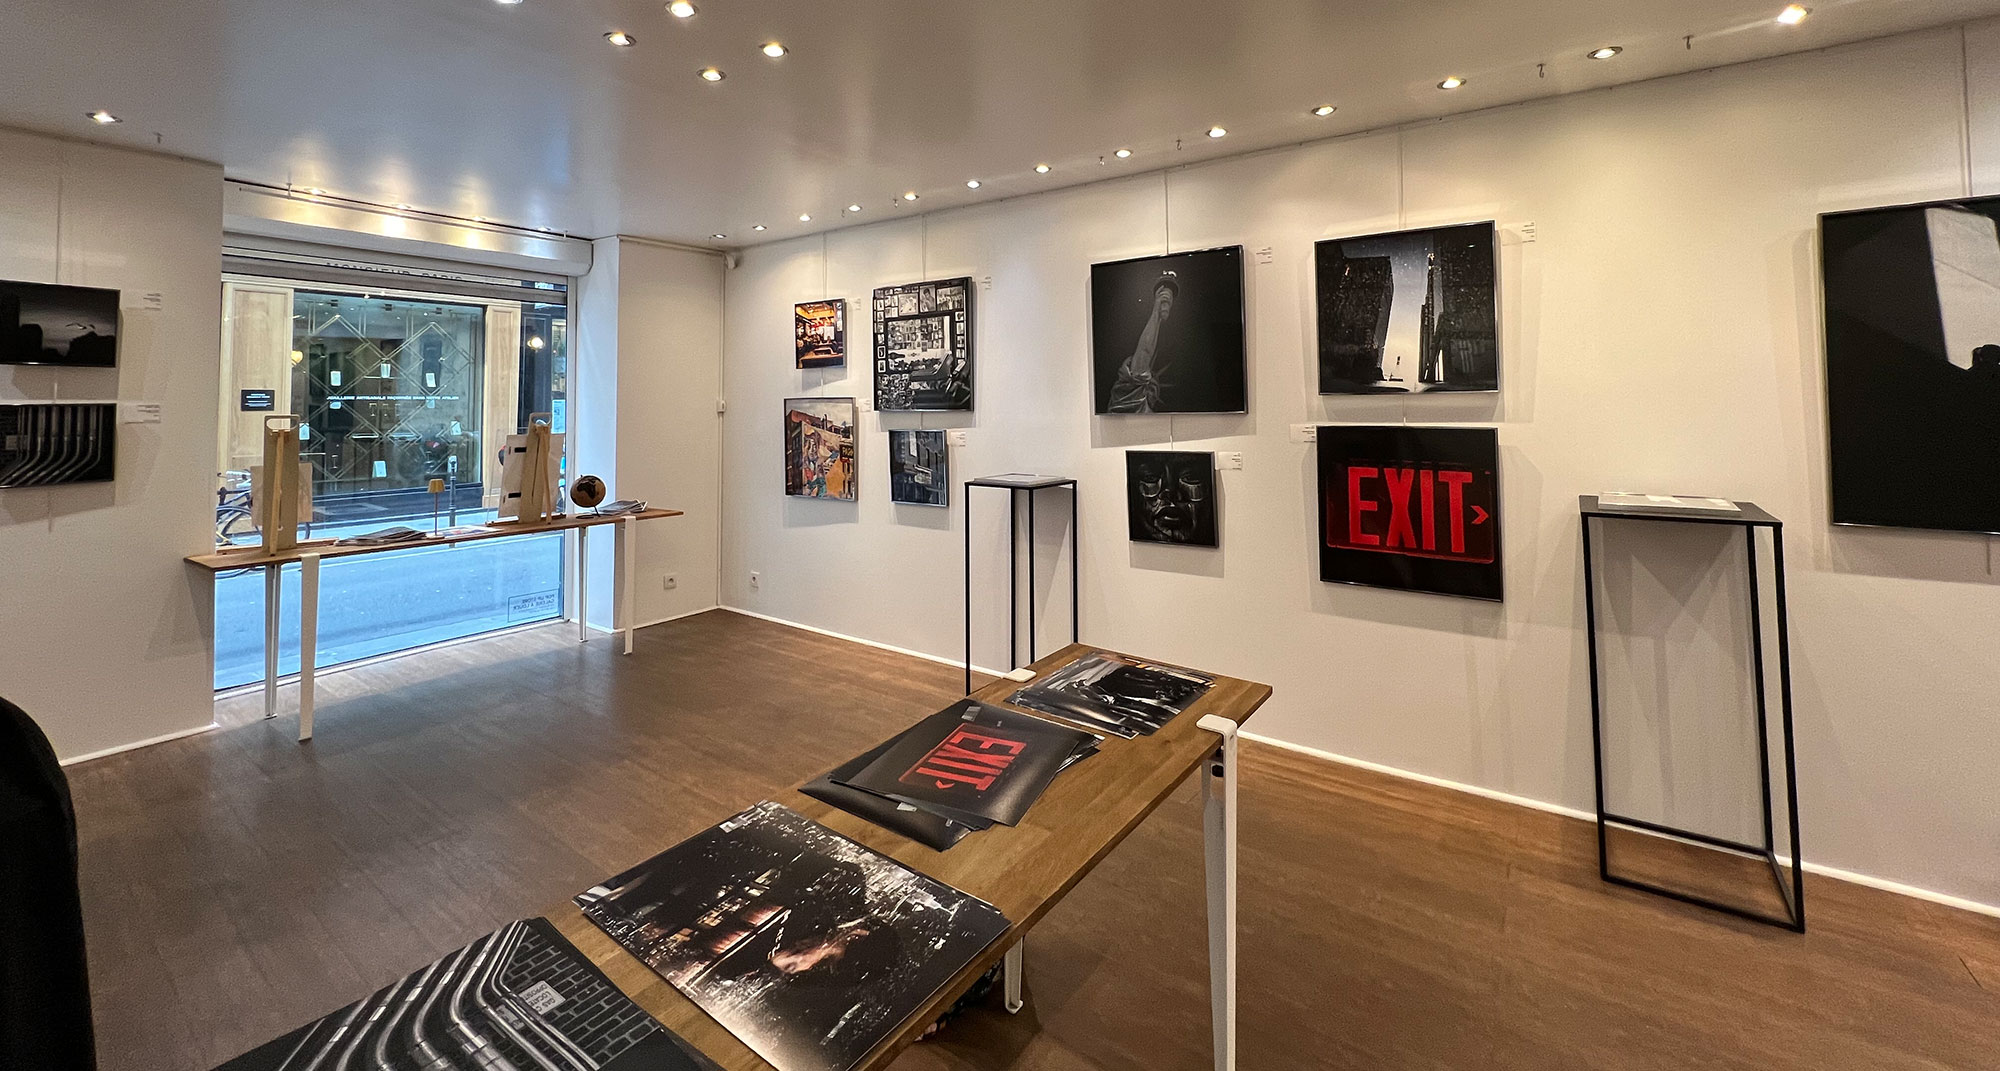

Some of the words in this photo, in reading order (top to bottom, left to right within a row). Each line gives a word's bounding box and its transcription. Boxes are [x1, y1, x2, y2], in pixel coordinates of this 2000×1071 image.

[1348, 467, 1473, 553] EXIT
[916, 731, 1027, 790] EXIT
[541, 998, 556, 1008] GAS
